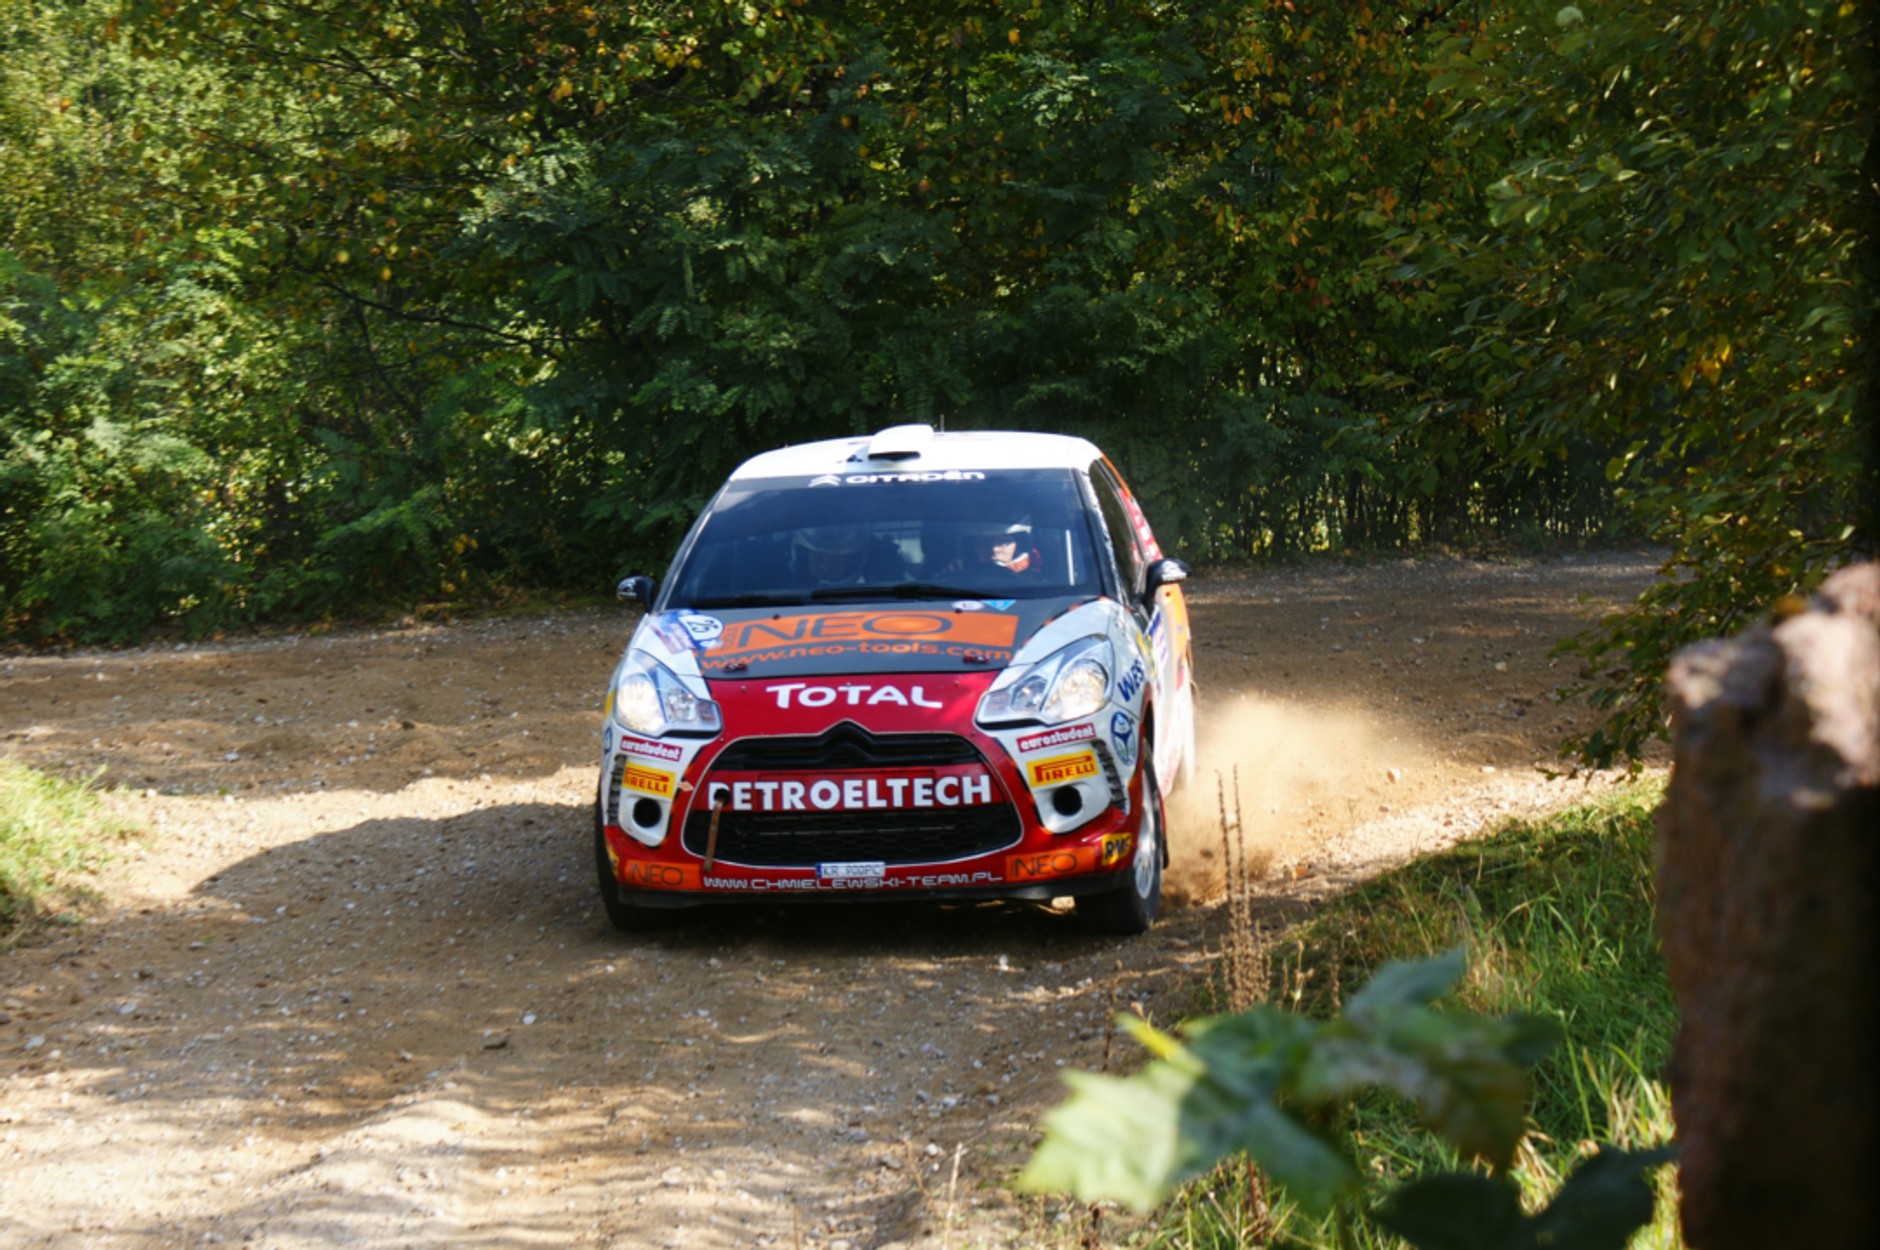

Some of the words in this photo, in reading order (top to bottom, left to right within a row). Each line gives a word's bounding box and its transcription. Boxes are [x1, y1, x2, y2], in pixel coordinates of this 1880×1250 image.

[737, 613, 953, 648] NEO
[702, 641, 1012, 670] www.neo-tools.com
[766, 682, 943, 709] TOTAL
[1020, 725, 1094, 750] eurostudent
[1034, 756, 1095, 783] PIRELLI
[629, 863, 684, 886] NEO
[1014, 853, 1078, 877] NEO
[703, 871, 1004, 891] WWW.CHMIELEWSKI-TEAM.PL
